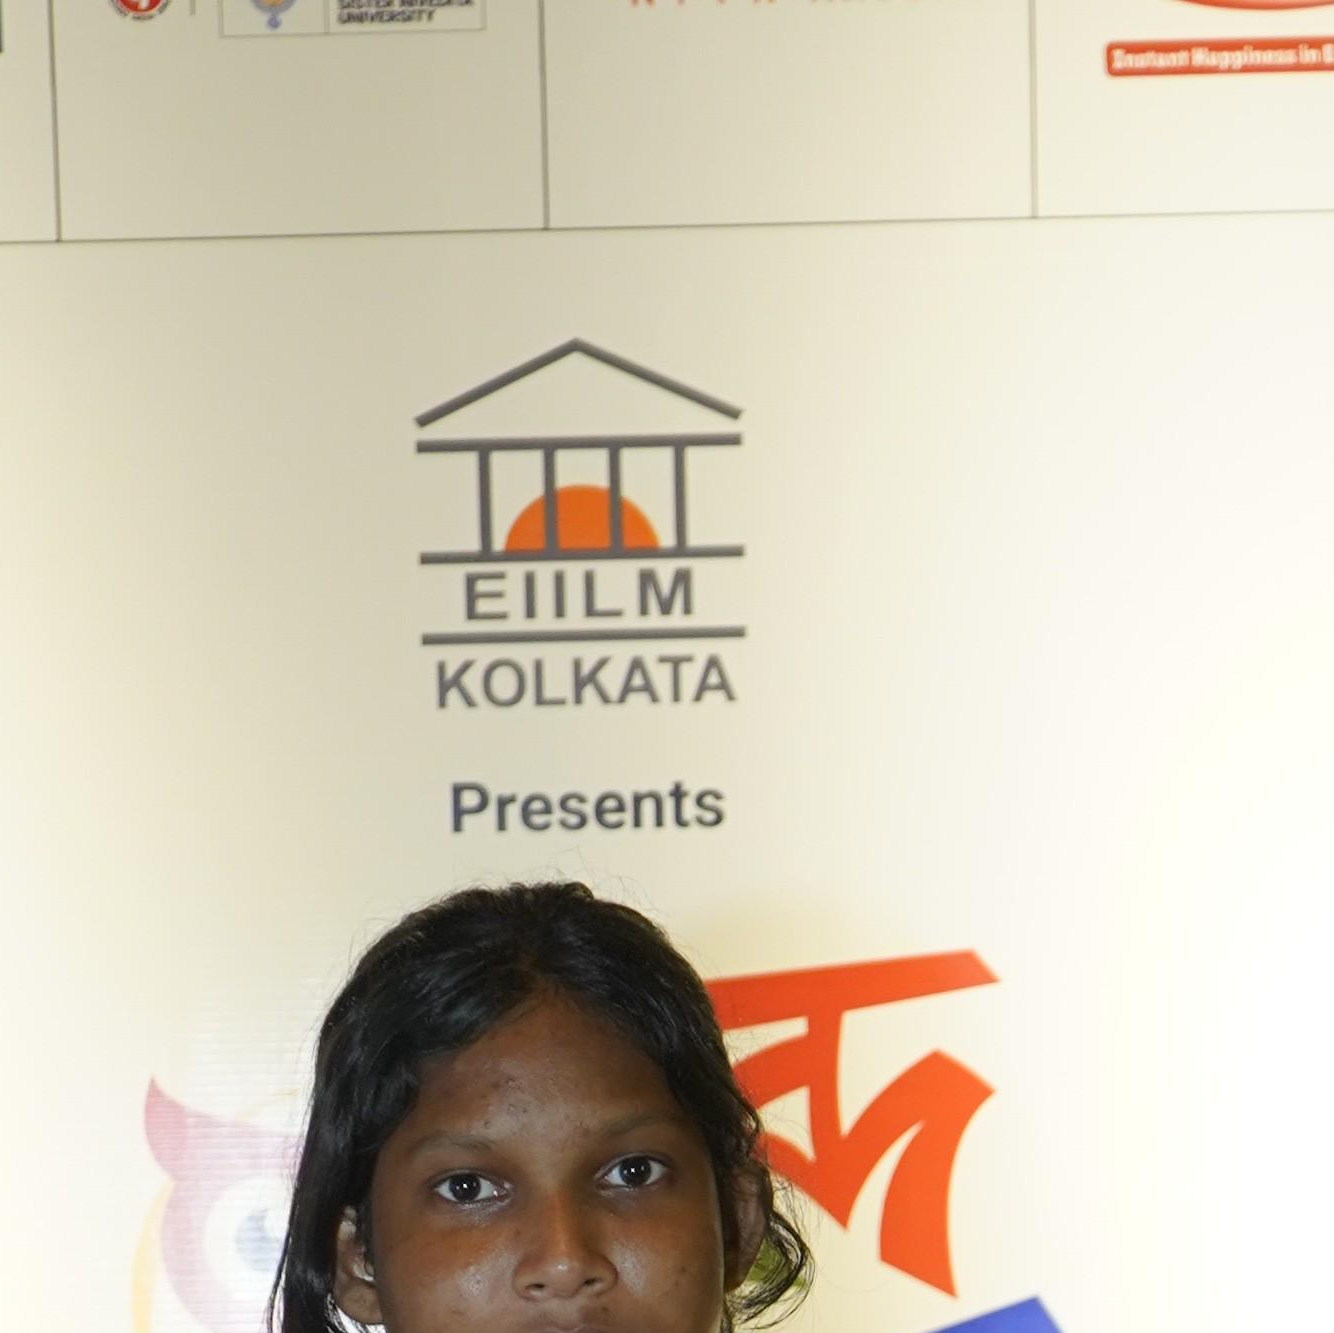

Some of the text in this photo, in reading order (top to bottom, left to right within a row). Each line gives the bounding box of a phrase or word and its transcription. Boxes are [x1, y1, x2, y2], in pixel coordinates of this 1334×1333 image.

[464, 566, 694, 621] EIILM
[436, 653, 737, 709] KOLKATA
[450, 780, 726, 833] Presents
